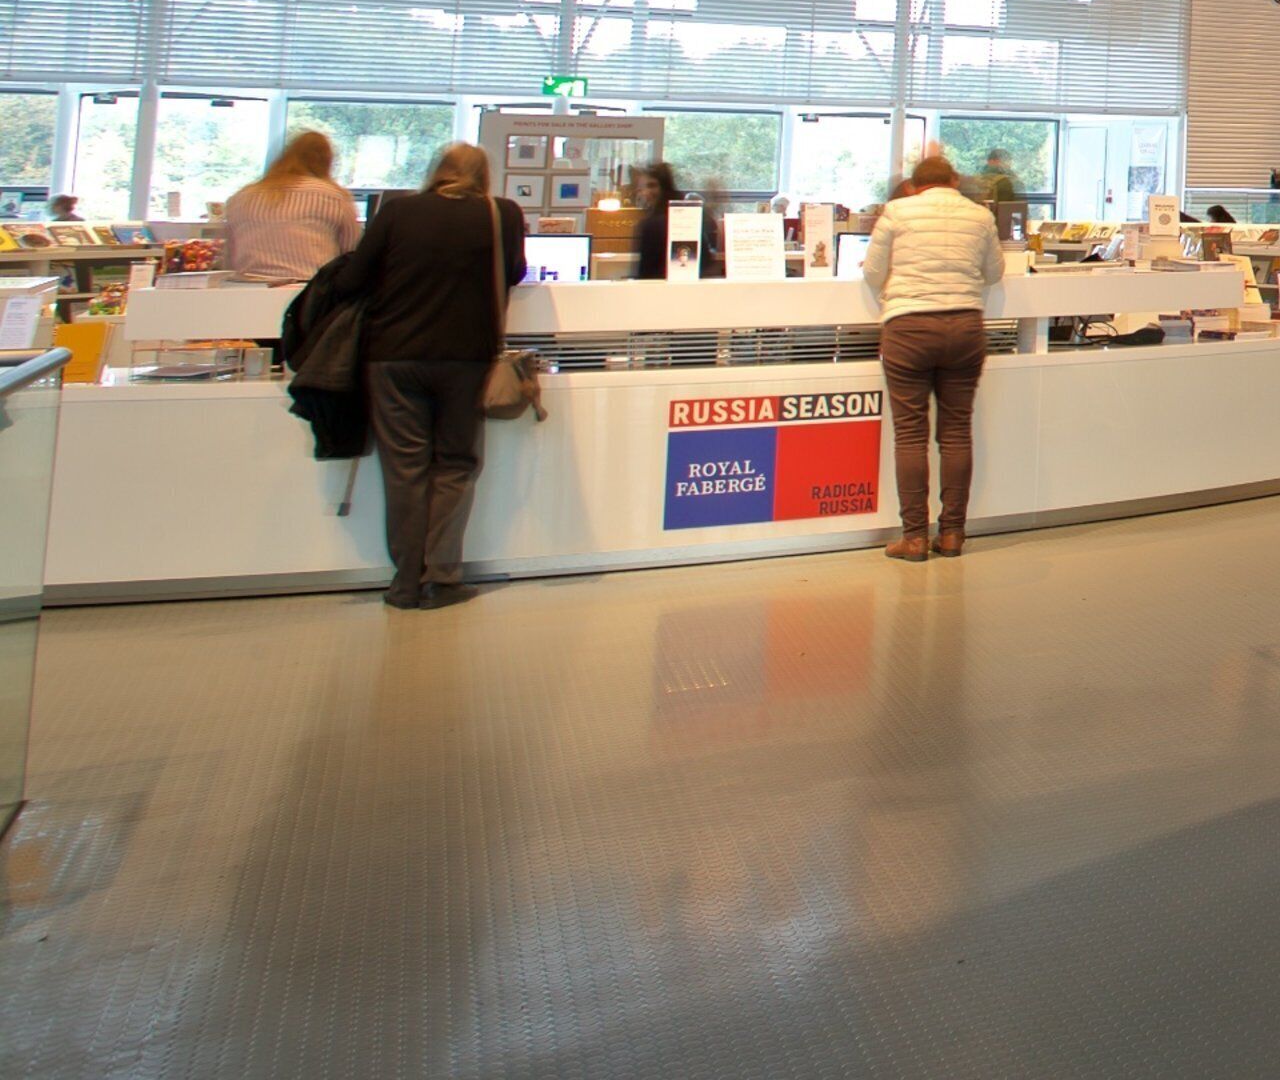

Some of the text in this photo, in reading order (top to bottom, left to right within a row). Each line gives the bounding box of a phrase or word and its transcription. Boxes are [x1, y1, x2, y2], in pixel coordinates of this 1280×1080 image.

[673, 393, 880, 424] RUSSIA SEASON
[689, 460, 755, 478] ROYAL
[676, 473, 766, 496] FABERGÉ
[812, 482, 874, 499] RADICAL
[819, 498, 873, 514] RUSSIA
